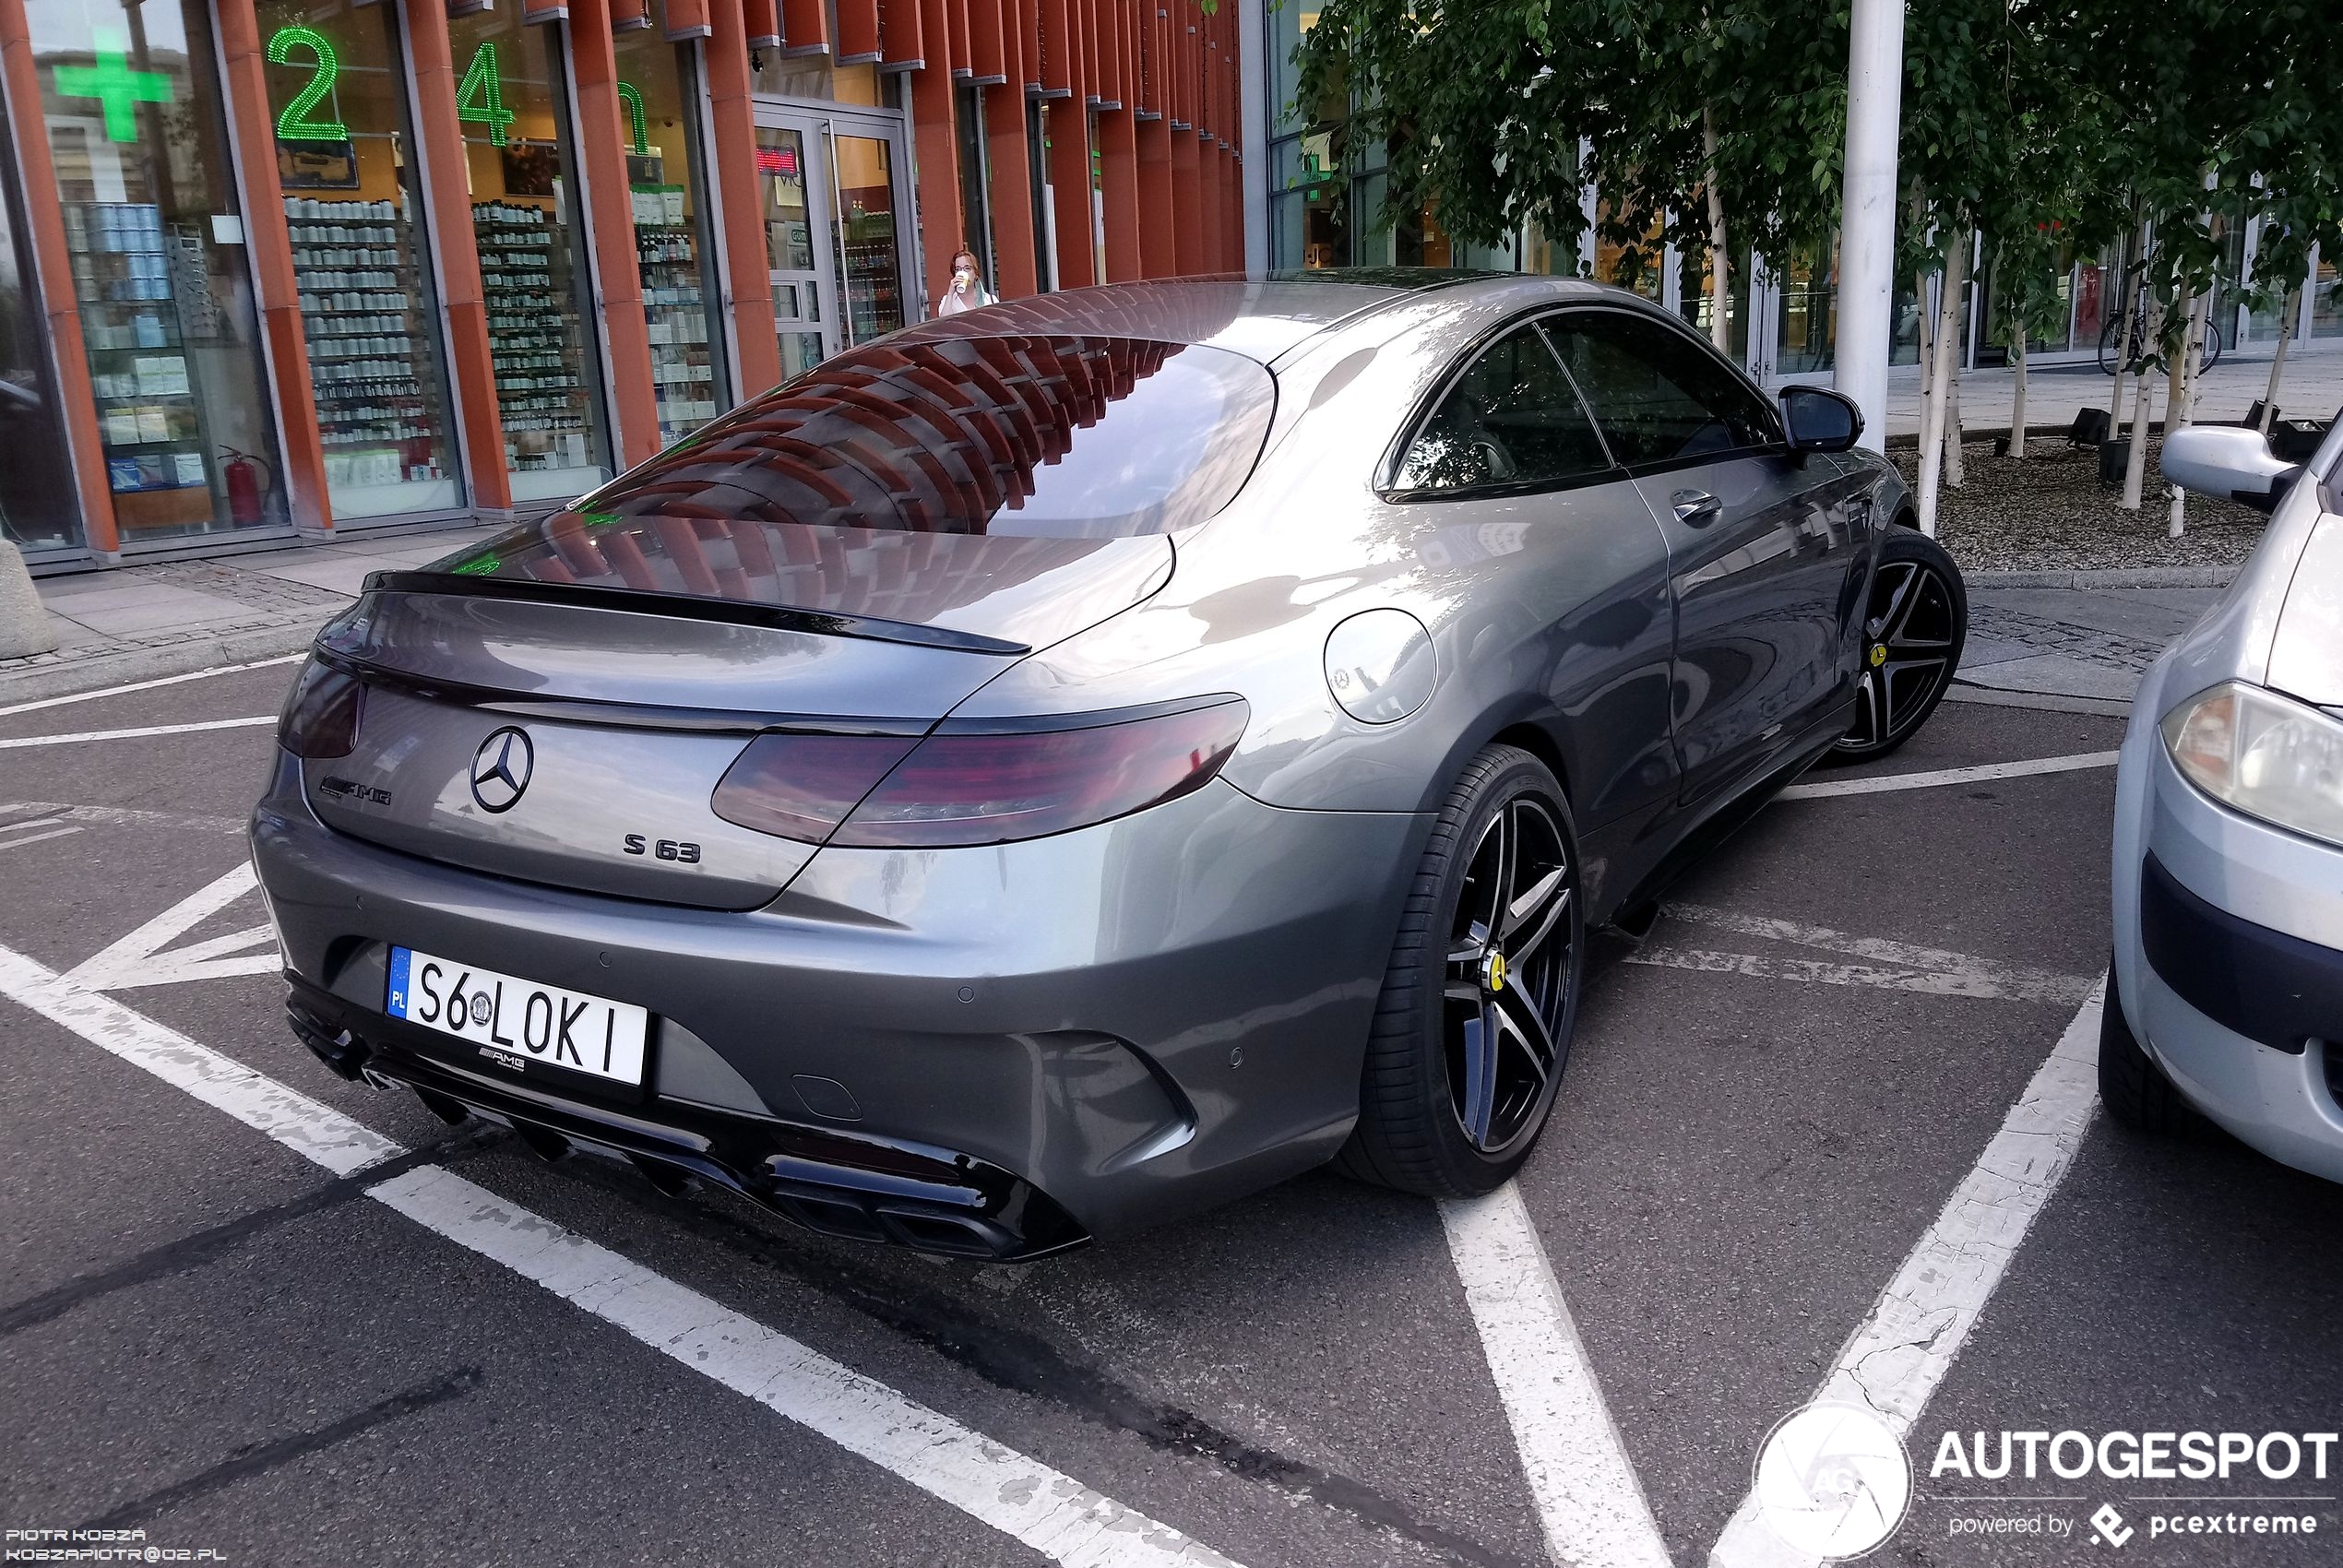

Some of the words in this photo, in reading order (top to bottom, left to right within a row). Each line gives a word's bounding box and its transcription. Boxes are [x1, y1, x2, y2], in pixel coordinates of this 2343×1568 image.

[623, 833, 647, 856] S
[655, 838, 701, 864] 63
[392, 991, 406, 1010] PL
[419, 962, 470, 1031] S6
[491, 980, 615, 1073] LOKI
[492, 1051, 525, 1069] AMG
